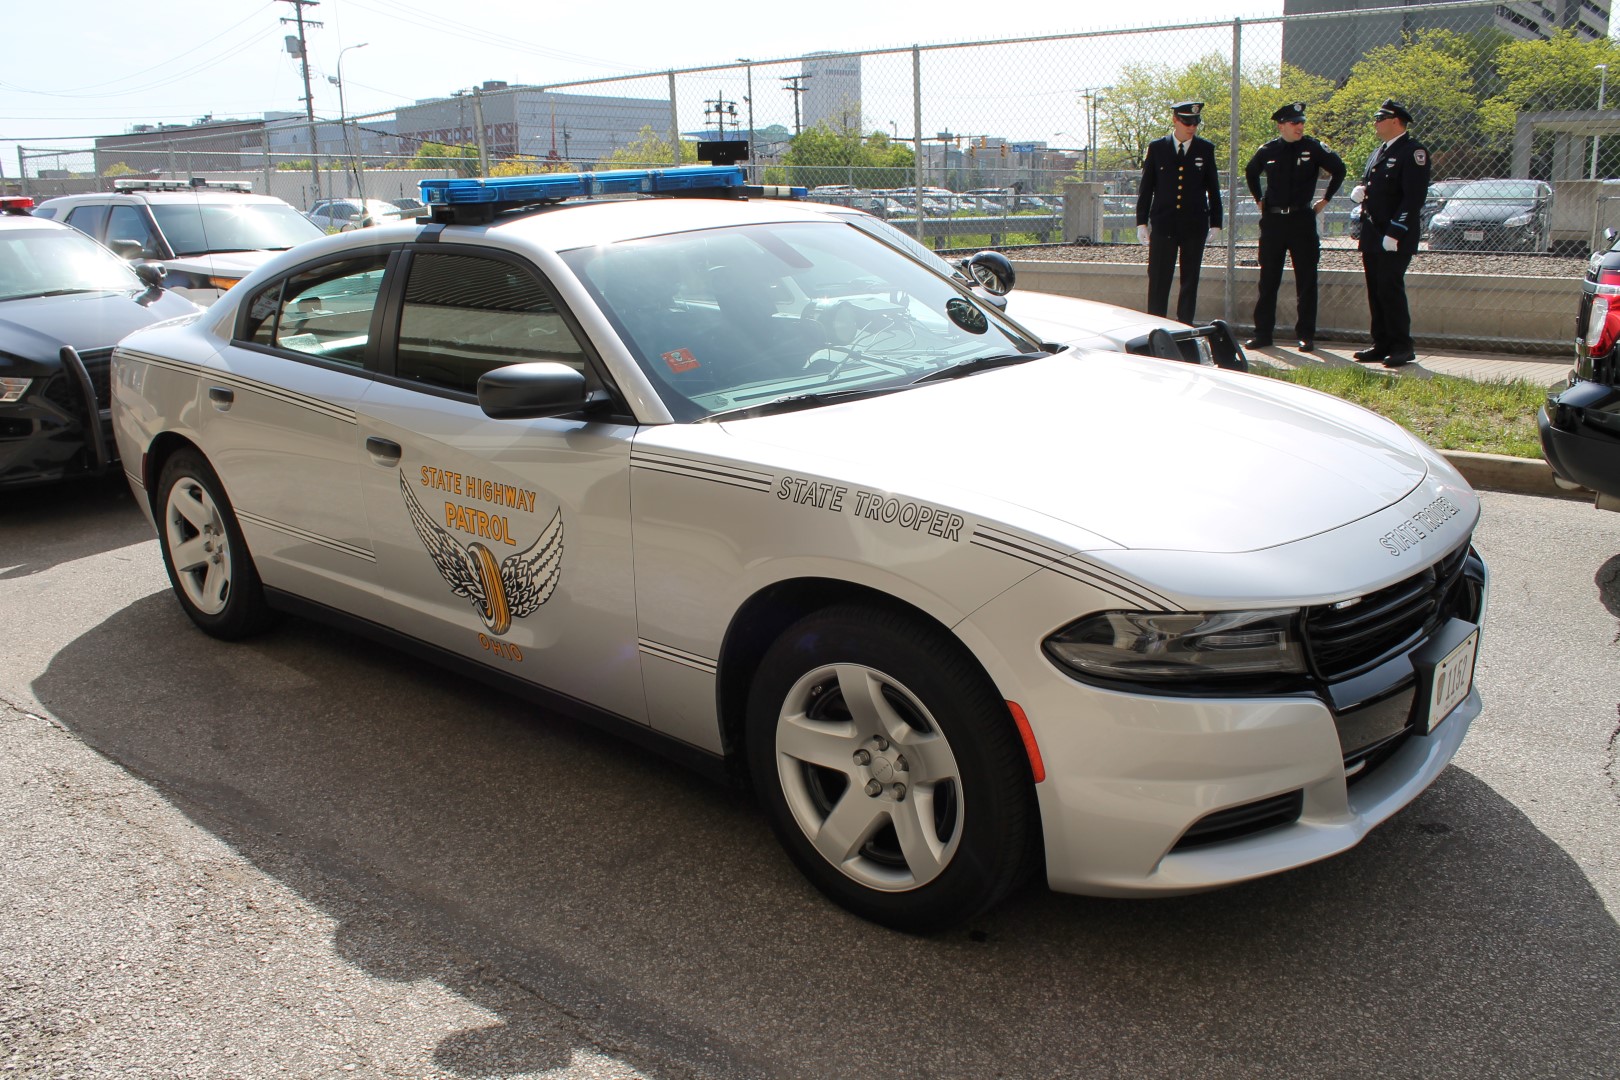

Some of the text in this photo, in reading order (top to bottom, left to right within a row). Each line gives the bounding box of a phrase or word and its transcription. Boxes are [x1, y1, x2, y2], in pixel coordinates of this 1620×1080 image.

[421, 465, 537, 513] STATE HIGHWAY
[777, 476, 965, 542] STATE TROOPER
[444, 501, 517, 546] PATROL
[1379, 496, 1461, 556] STATE TROOPER
[478, 632, 524, 663] OHIO
[1445, 654, 1468, 701] 1152
